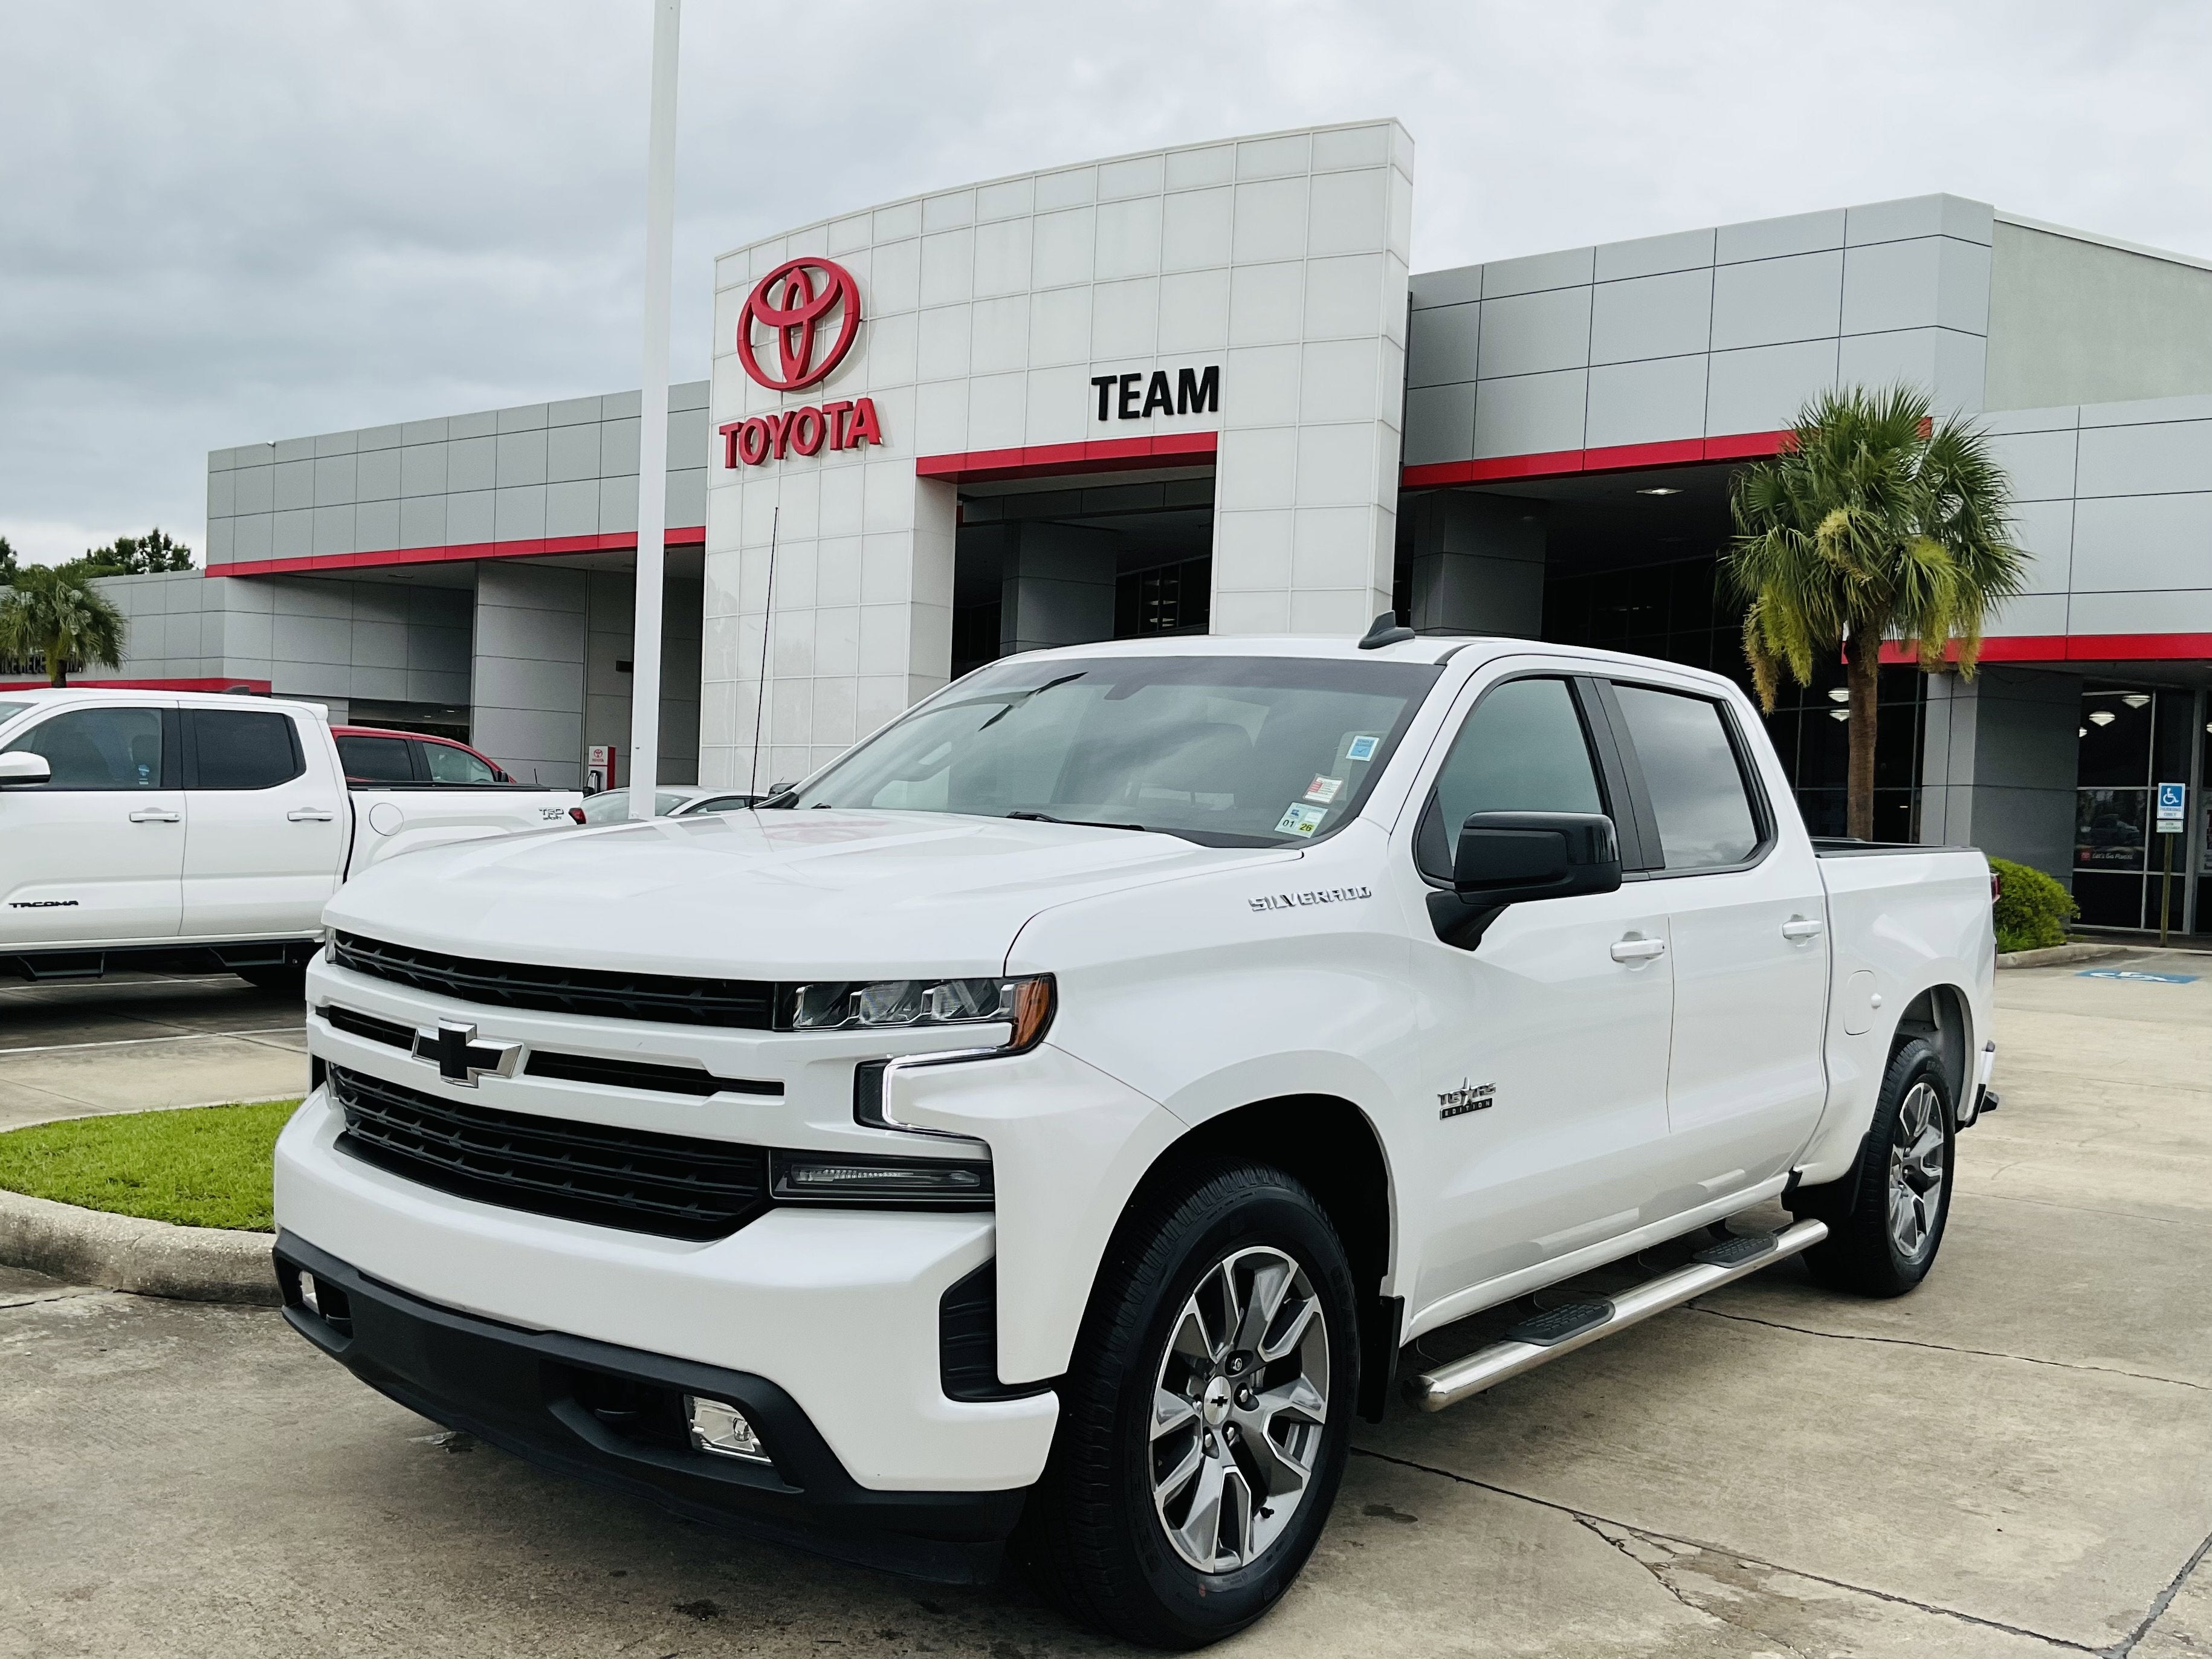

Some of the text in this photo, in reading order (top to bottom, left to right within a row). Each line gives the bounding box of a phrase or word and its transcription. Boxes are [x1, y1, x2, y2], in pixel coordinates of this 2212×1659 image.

[1091, 365, 1219, 421] TEAM
[719, 397, 882, 469] TOYOTA
[538, 807, 564, 816] TRD
[1299, 823, 1313, 832] 26
[1248, 885, 1372, 911] SILVERADO
[1444, 1100, 1491, 1117] EDITION
